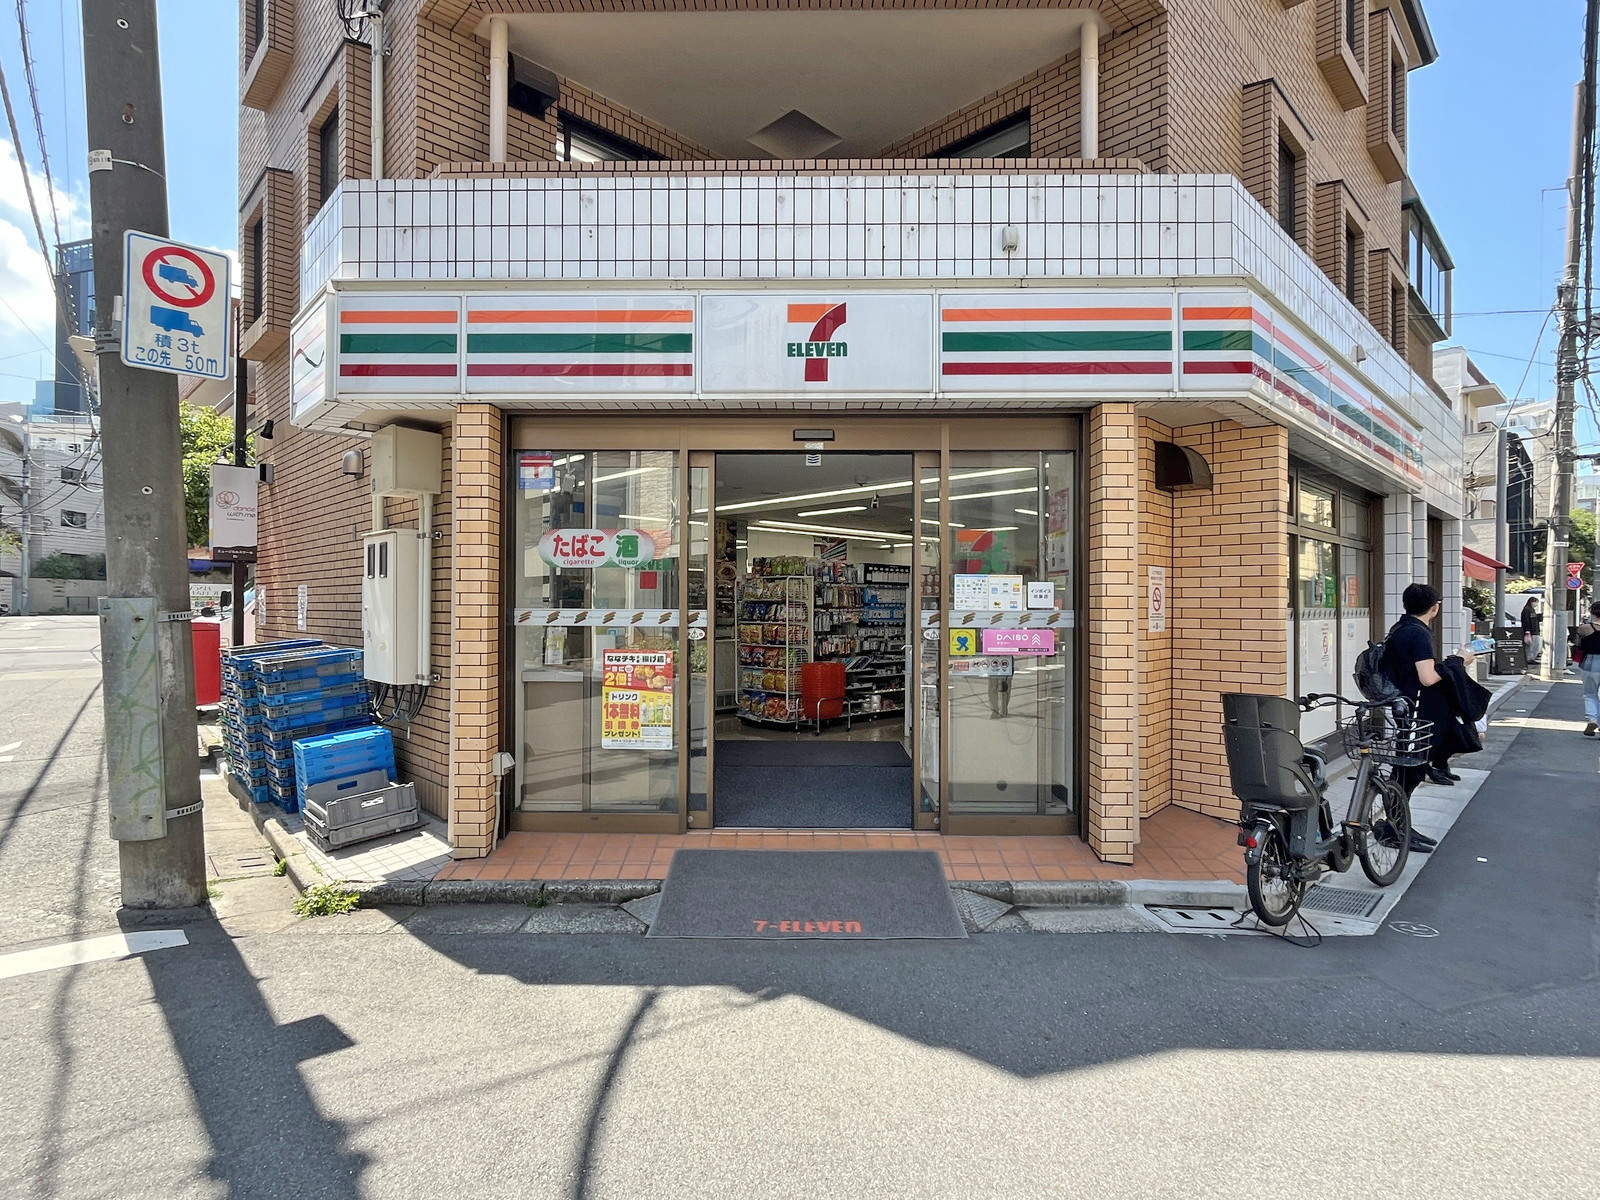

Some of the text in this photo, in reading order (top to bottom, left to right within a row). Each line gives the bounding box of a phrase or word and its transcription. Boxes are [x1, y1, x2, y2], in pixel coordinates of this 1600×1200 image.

[155, 333, 200, 354] 積 3t
[135, 346, 218, 374] この先 50m
[553, 534, 605, 557] たばこ
[616, 535, 639, 558] 酒
